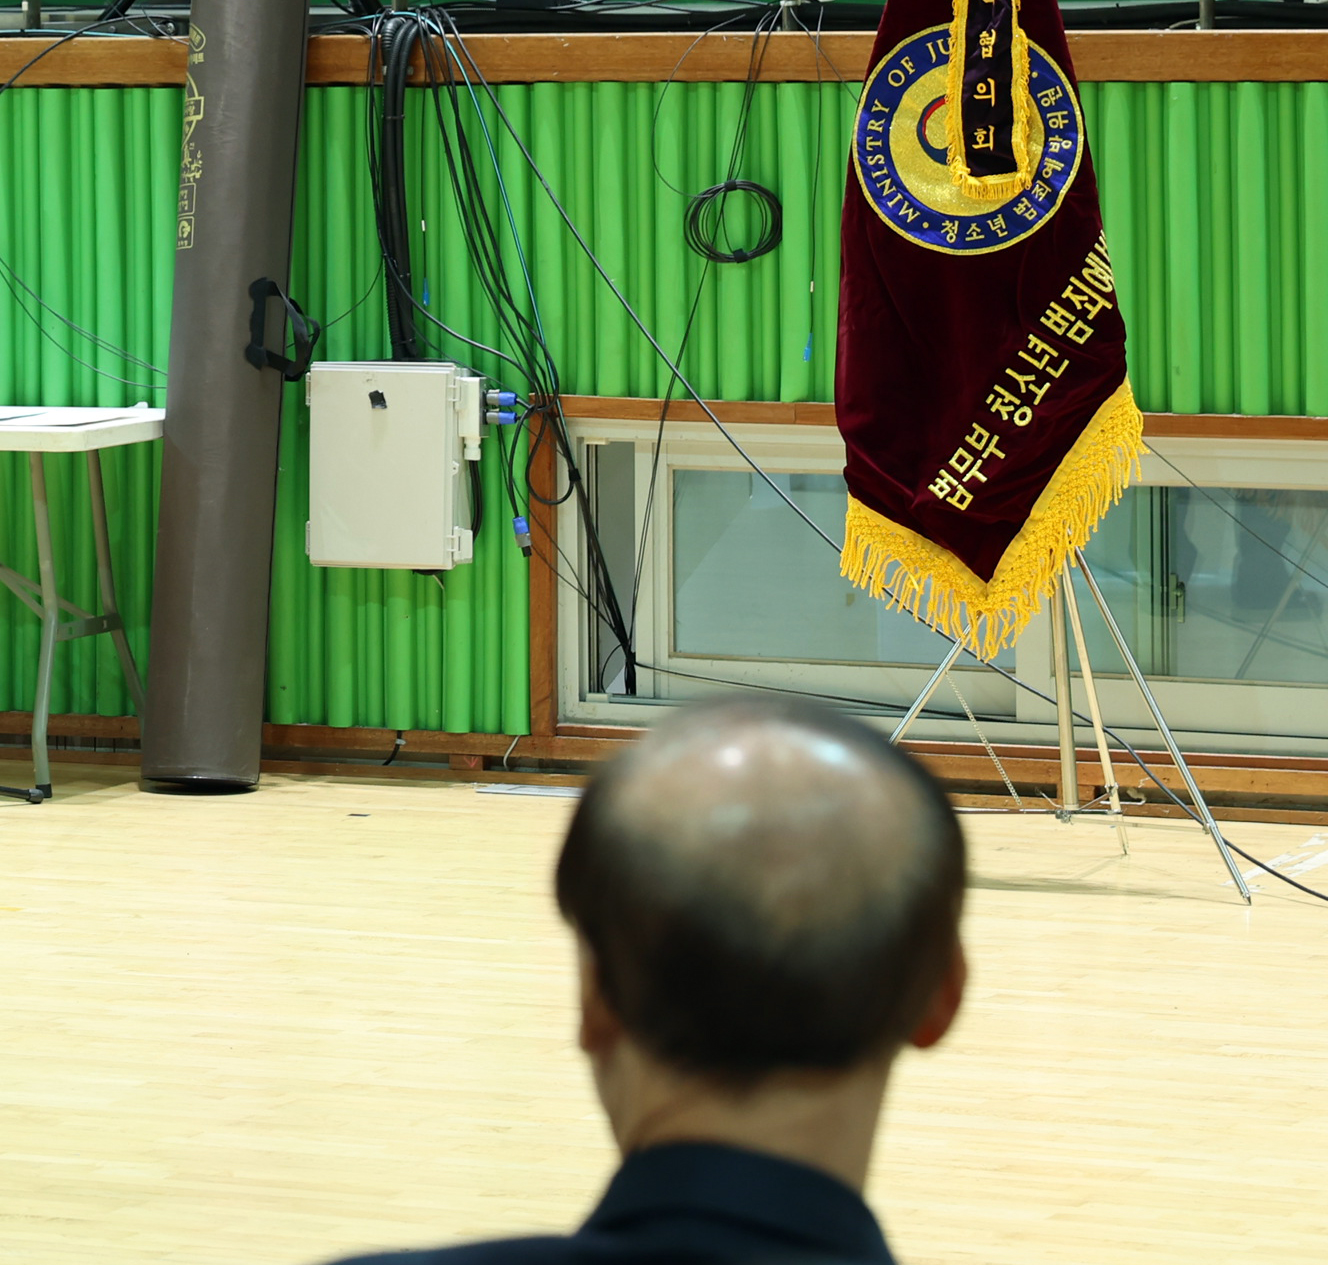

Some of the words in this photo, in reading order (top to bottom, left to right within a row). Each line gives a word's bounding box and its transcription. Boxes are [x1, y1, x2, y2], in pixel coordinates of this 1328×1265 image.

[887, 56, 917, 88] OF
[865, 98, 920, 224] MINISTRY
[940, 215, 1008, 243] 청소년
[1013, 85, 1072, 221] 범죄예방위원
[928, 422, 1006, 511] 법무부
[986, 334, 1070, 427] 청소년
